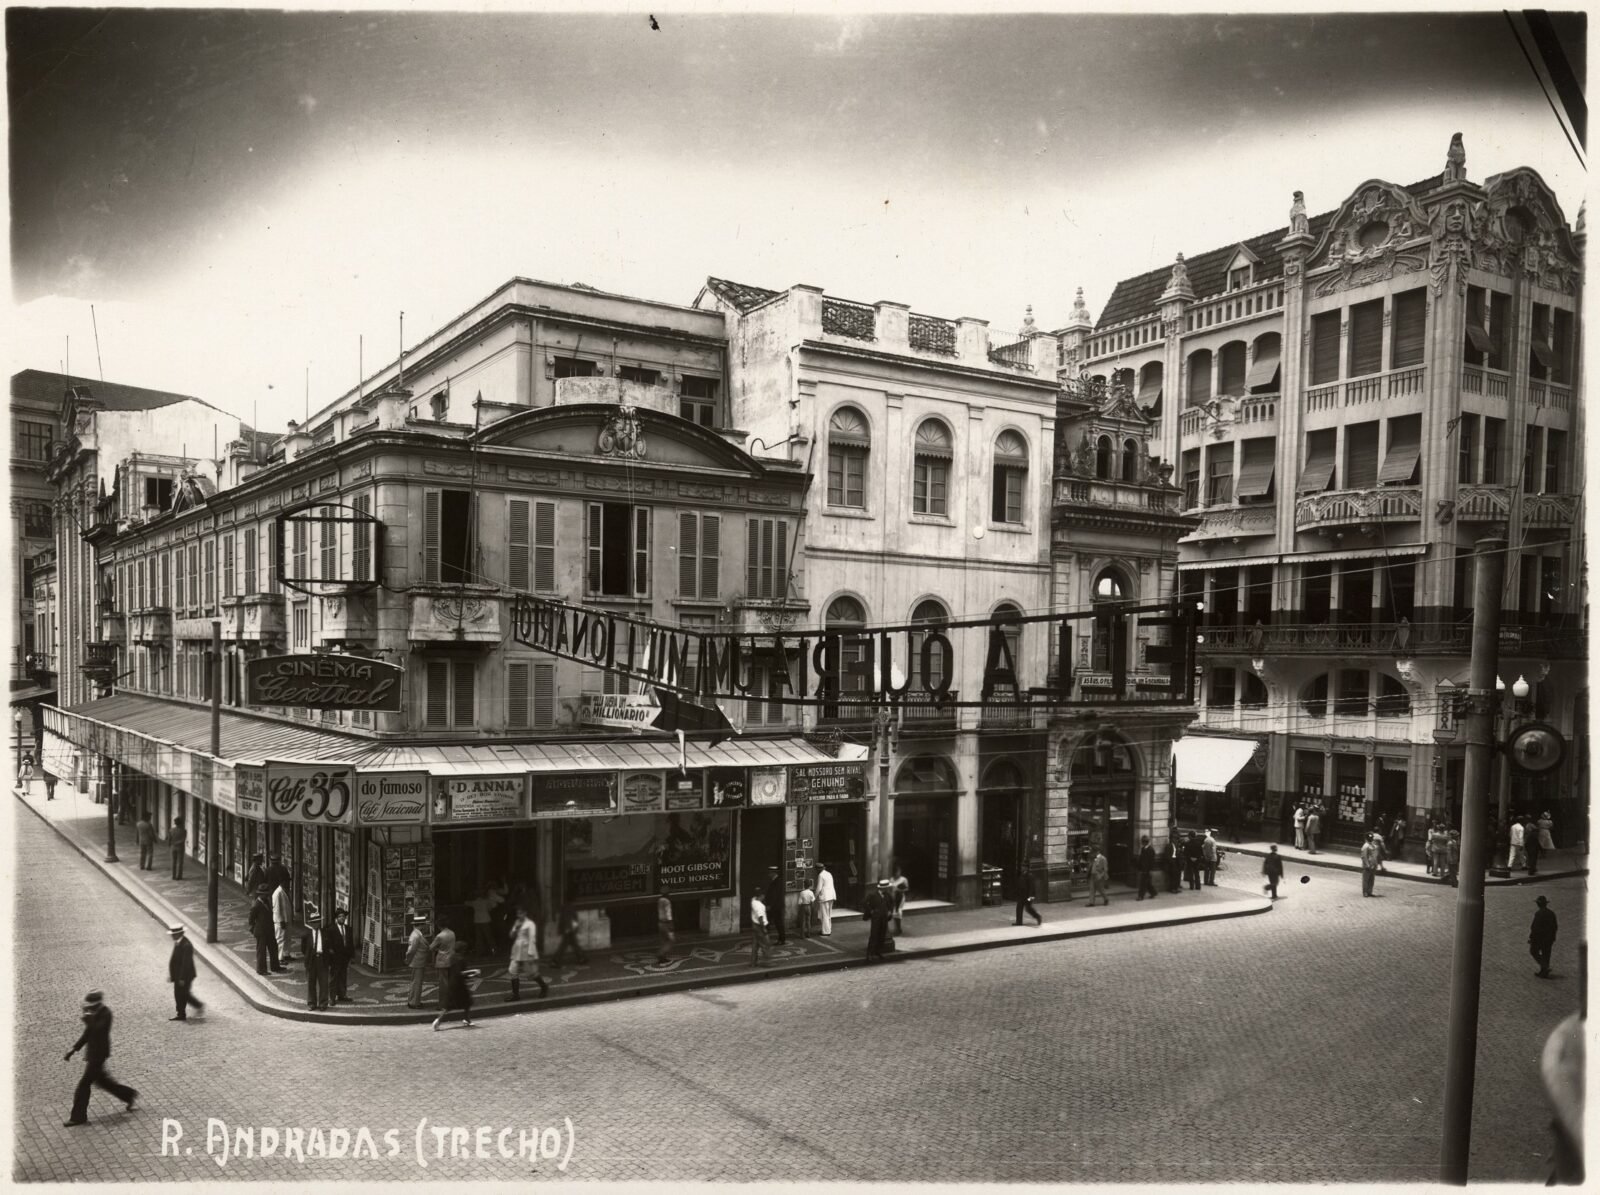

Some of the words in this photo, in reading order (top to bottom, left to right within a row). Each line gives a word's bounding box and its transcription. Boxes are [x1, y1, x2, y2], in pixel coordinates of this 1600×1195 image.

[276, 660, 373, 678] CINEMA
[256, 672, 395, 705] Central
[795, 768, 806, 777] SAL
[846, 765, 861, 775] RIVAL
[361, 780, 377, 795] do
[378, 777, 422, 800] famoso
[811, 776, 845, 788] GENUINO
[302, 770, 350, 822] 35
[381, 799, 425, 818] Nacional
[661, 864, 686, 874] HOOT
[687, 862, 722, 872] GIBSON
[660, 876, 686, 885] WILD
[688, 873, 721, 883] HORSE
